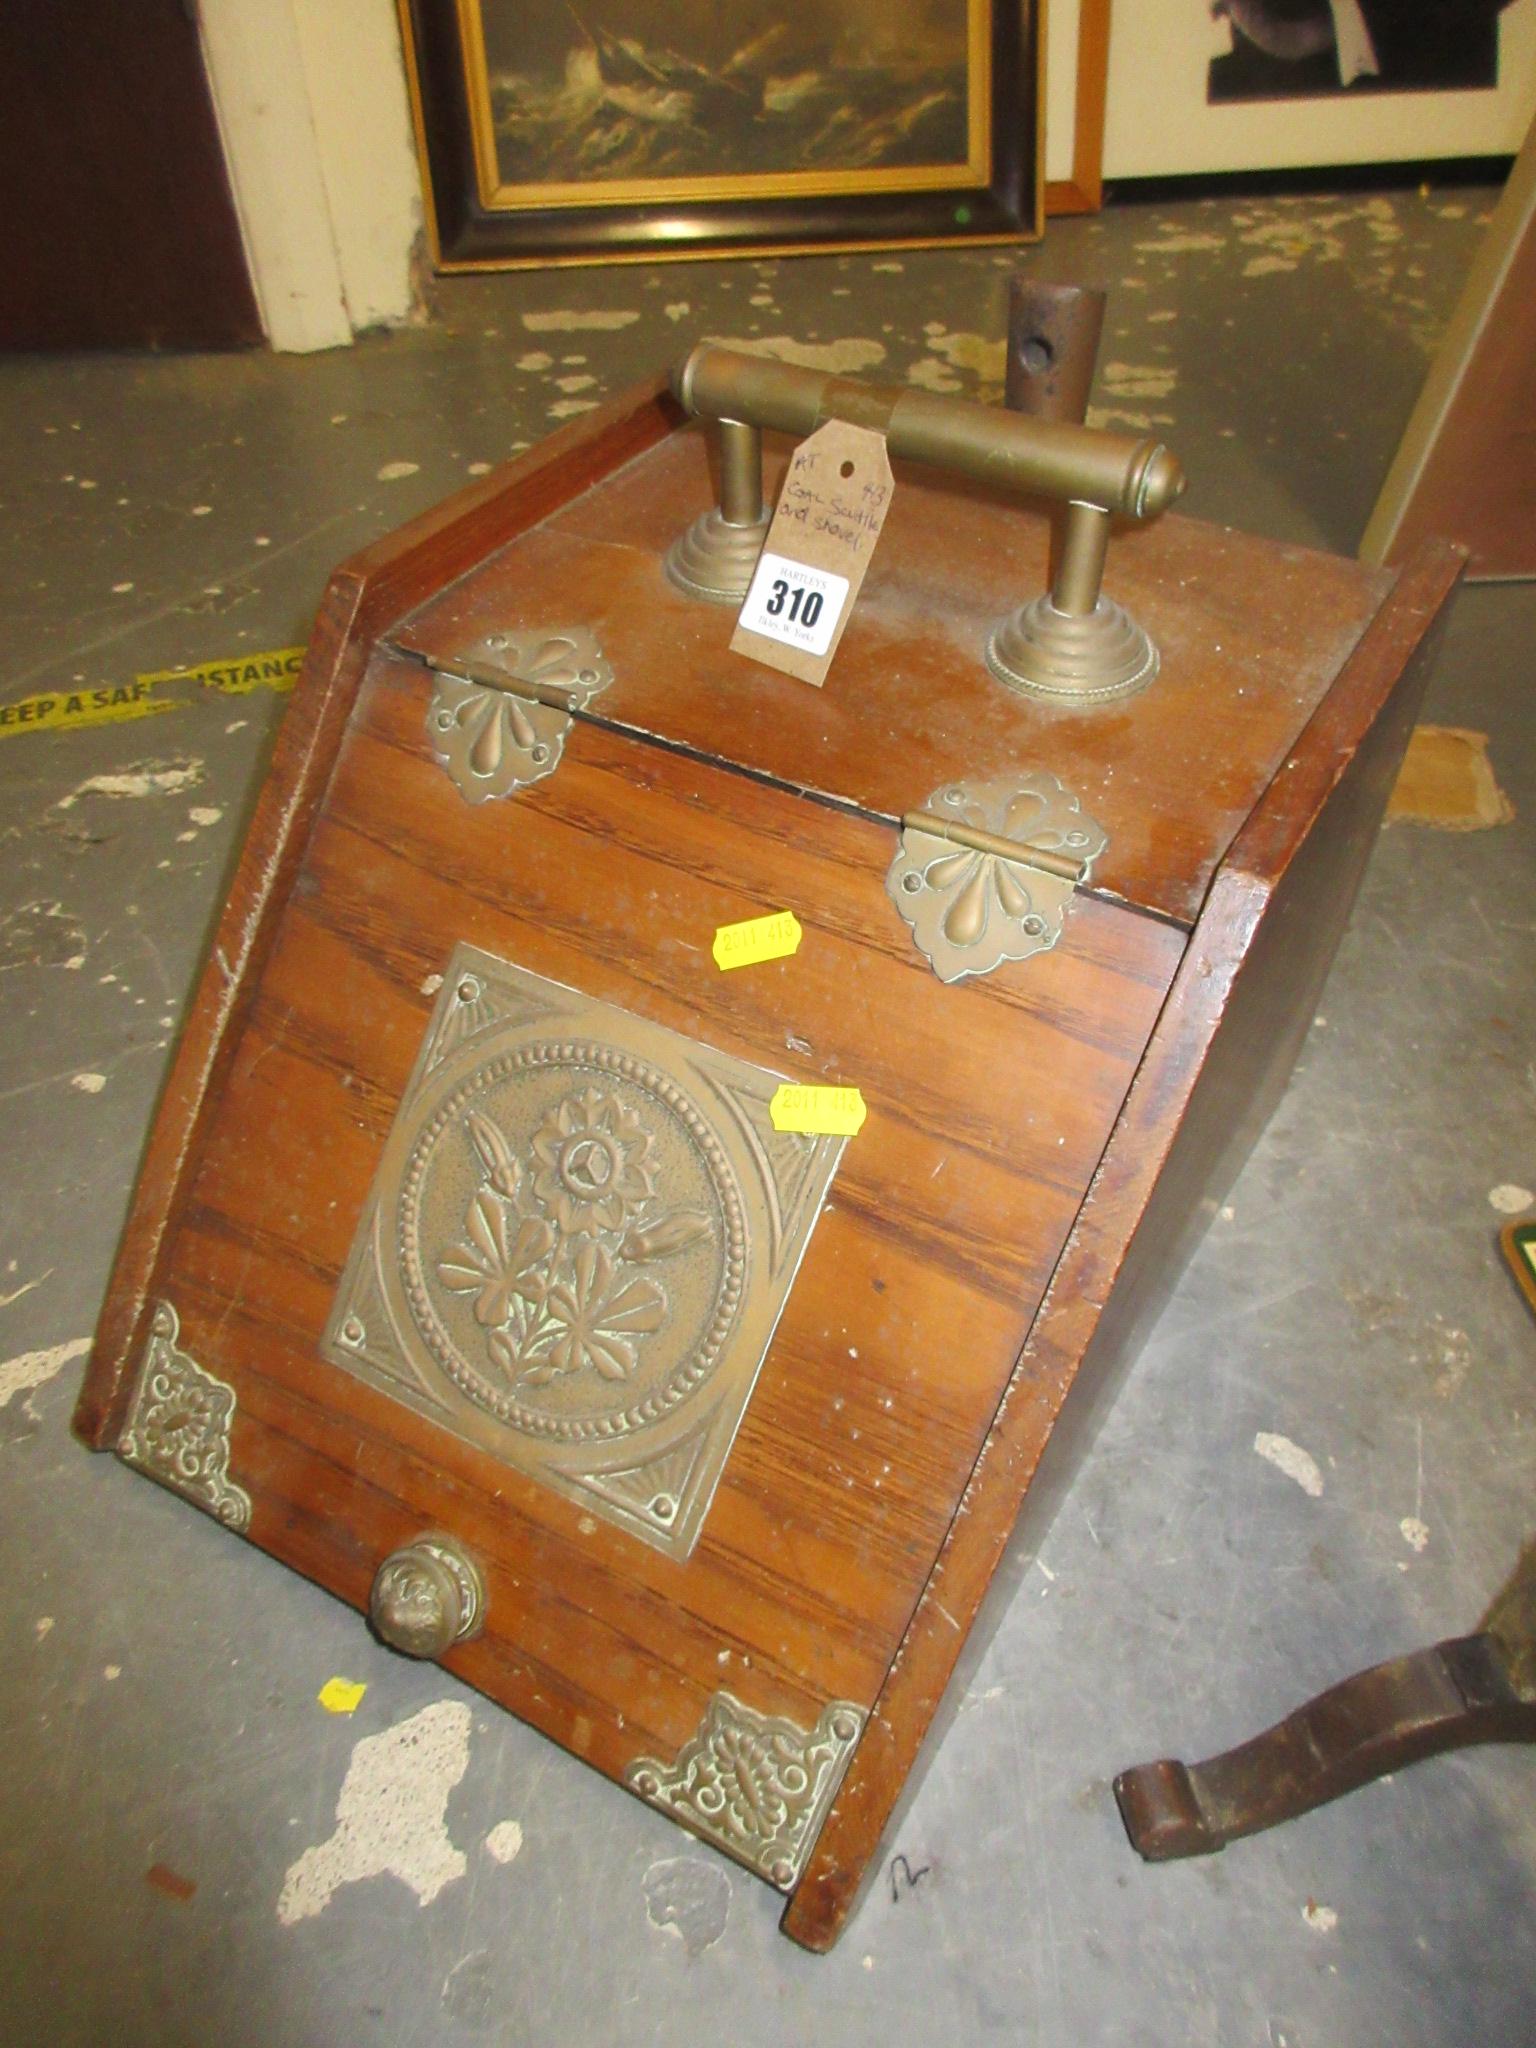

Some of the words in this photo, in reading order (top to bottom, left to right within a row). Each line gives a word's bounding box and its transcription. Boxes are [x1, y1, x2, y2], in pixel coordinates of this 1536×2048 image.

[780, 567, 827, 590] HARTLEYS
[766, 579, 824, 628] 310
[0, 701, 56, 725] EEP
[64, 696, 84, 714] A
[92, 683, 152, 708] SAF
[196, 656, 302, 688] ISTANC
[723, 927, 757, 951] 2011
[767, 918, 793, 942] 413
[782, 1088, 818, 1109] 2011
